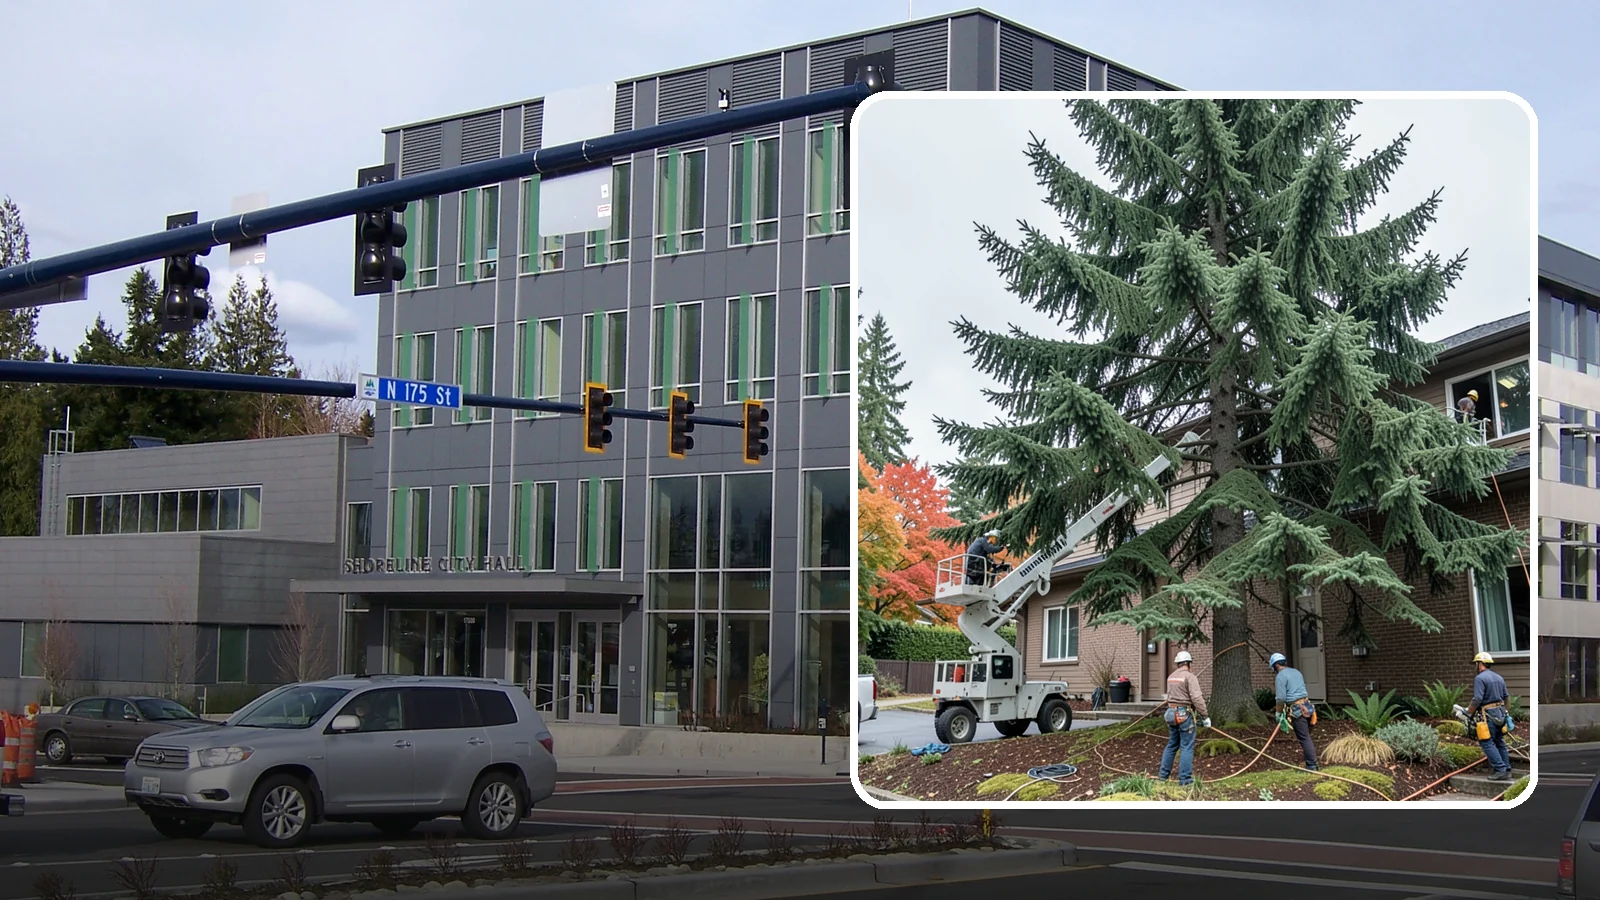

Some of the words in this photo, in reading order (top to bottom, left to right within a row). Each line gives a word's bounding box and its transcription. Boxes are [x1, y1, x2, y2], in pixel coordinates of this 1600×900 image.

[387, 380, 396, 399] N
[405, 382, 428, 403] 175
[436, 386, 451, 406] St
[344, 557, 432, 574] SHORELINE
[438, 555, 476, 572] CITY
[484, 554, 525, 571] HALL
